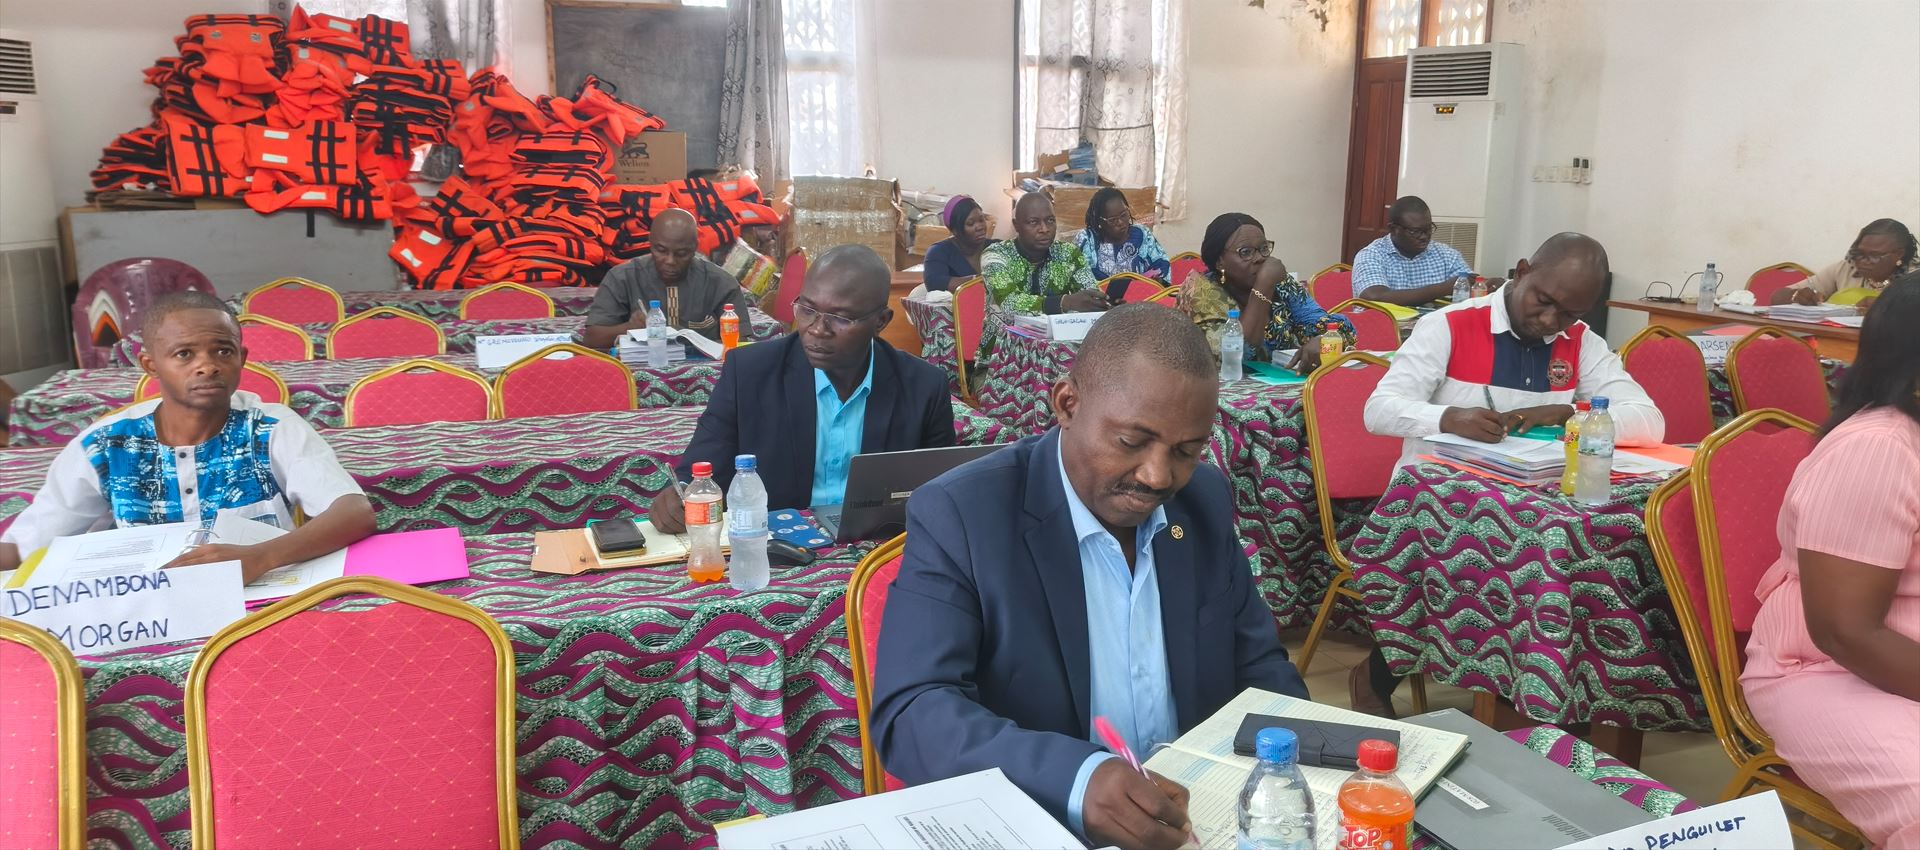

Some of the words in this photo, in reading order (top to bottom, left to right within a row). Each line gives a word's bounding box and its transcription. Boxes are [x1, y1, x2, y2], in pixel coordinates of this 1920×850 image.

[7, 571, 171, 616] DENAMBONA
[47, 618, 168, 651] MORGAN
[1344, 825, 1381, 849] TOP
